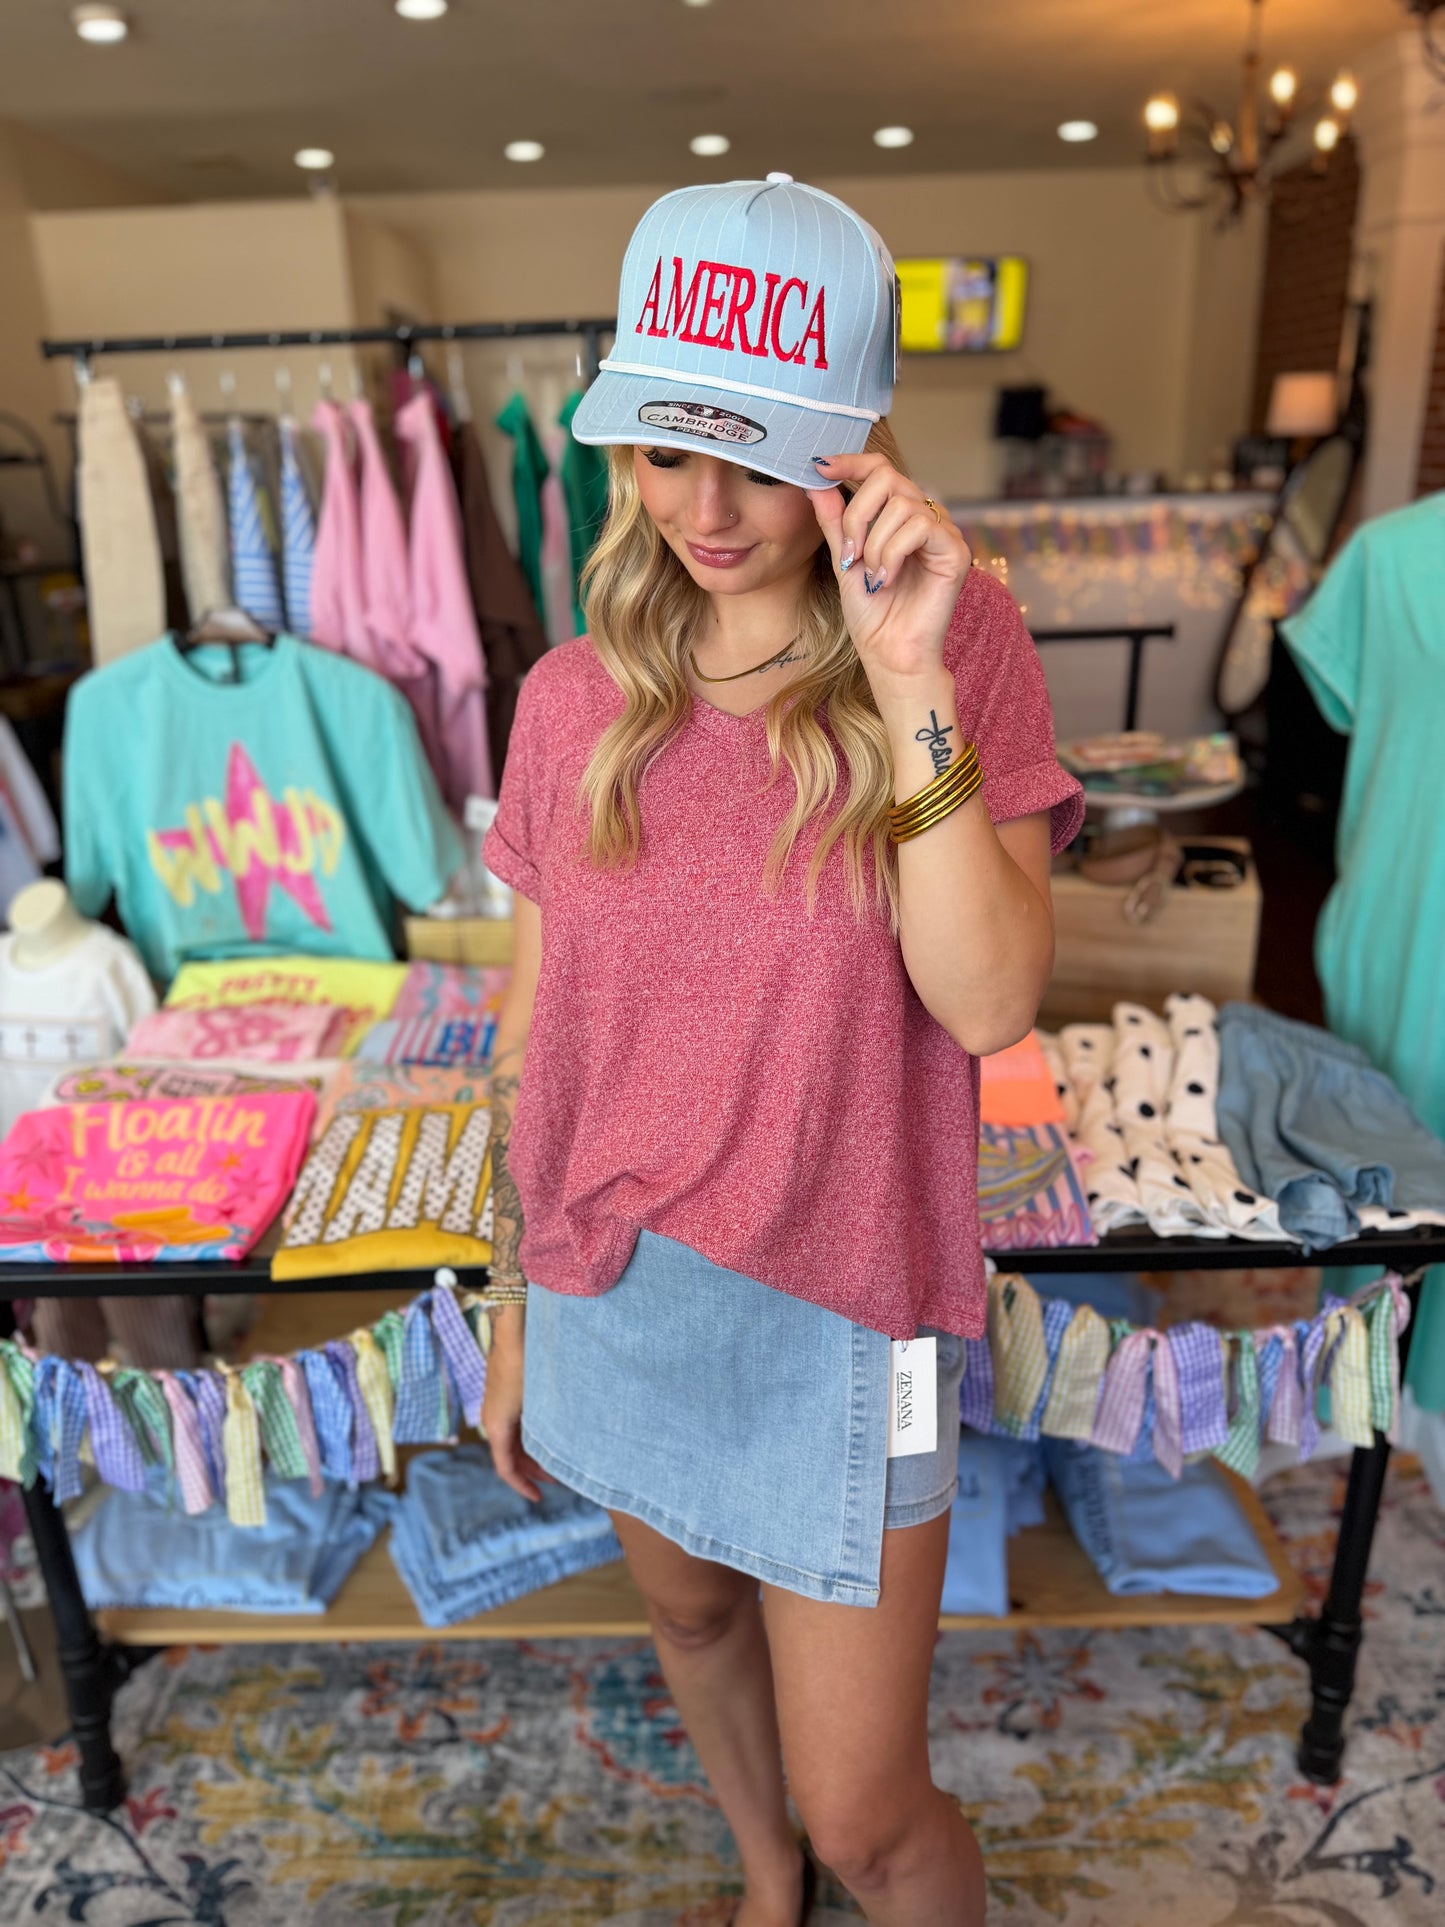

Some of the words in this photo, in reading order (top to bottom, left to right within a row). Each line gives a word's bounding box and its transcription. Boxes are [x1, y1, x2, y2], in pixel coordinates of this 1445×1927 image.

[635, 255, 829, 370] AMERICA
[647, 413, 748, 442] CAMBRIDGE
[719, 412, 744, 422] 2000
[915, 709, 953, 780] Jesu
[116, 1149, 151, 1178] is
[154, 1142, 208, 1177] all
[56, 1166, 84, 1202] I
[83, 1178, 184, 1202] wanna
[187, 1172, 229, 1204] do
[900, 1370, 913, 1430] ZENANA
